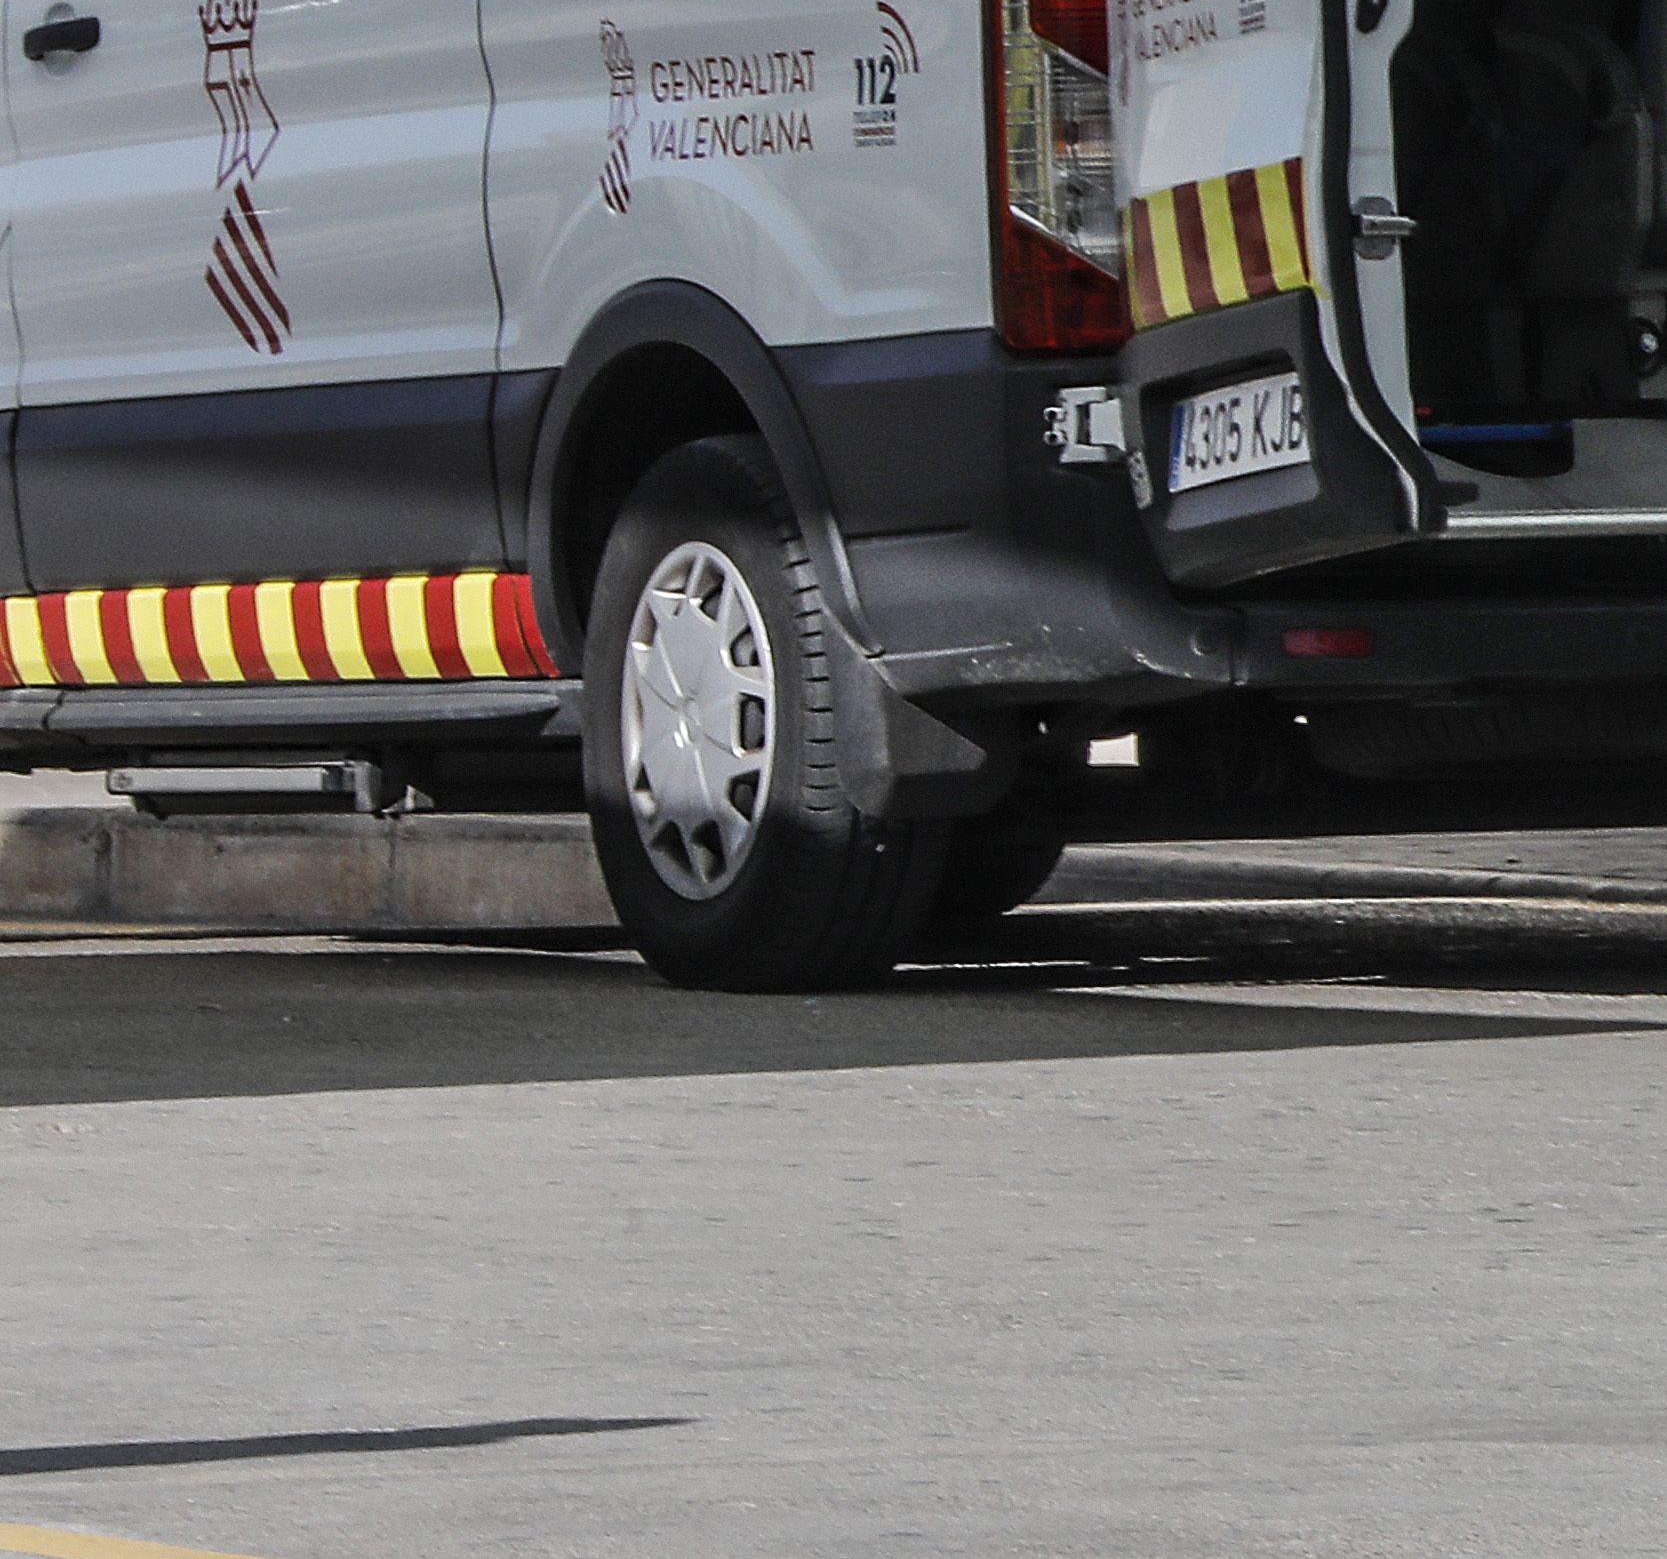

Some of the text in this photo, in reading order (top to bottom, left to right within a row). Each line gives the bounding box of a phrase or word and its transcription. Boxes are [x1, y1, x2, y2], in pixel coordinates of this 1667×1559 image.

[651, 50, 815, 102] GENERALITAT
[854, 54, 896, 105] 112
[650, 110, 814, 159] VALENCIANA
[1184, 385, 1302, 473] 4305 KJB
